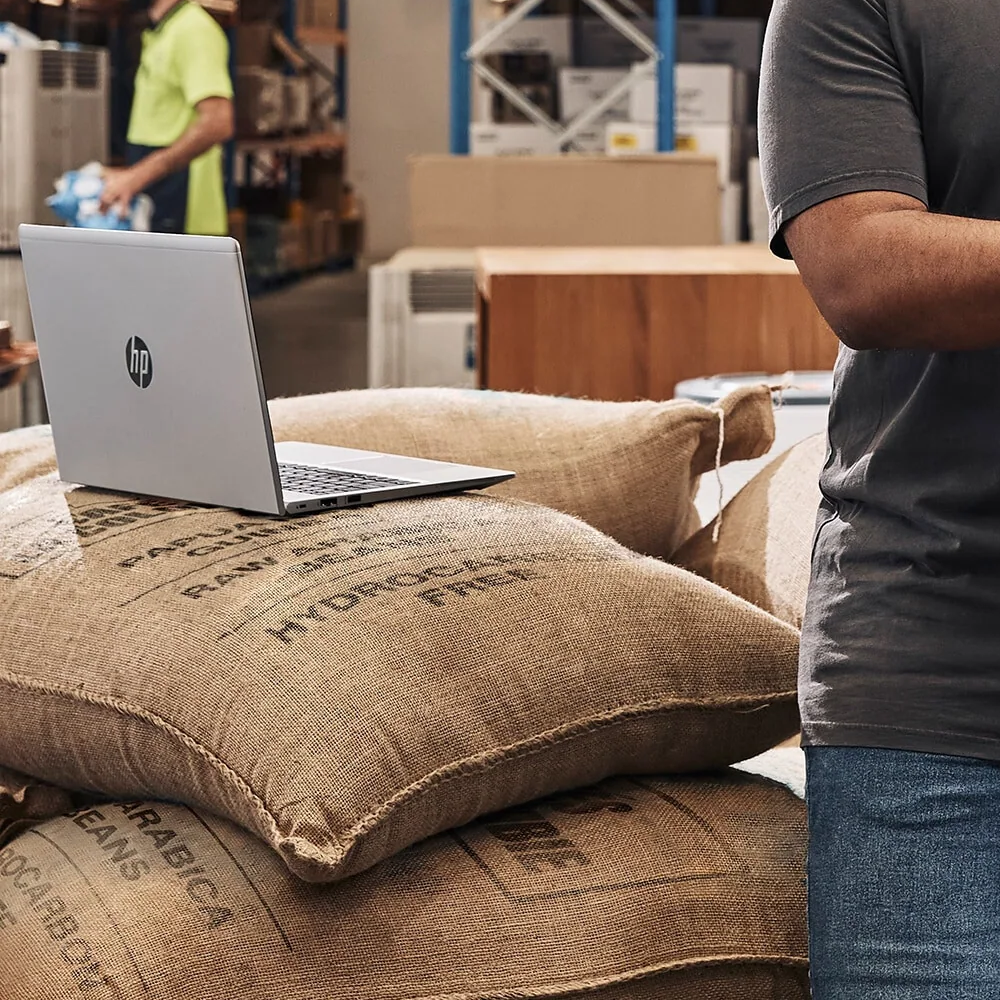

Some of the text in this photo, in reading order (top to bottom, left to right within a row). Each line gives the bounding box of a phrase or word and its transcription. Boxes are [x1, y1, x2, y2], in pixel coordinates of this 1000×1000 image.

[128, 335, 152, 389] hp
[116, 522, 270, 568] PAPUA
[180, 556, 279, 600] RAW
[68, 807, 151, 882] EANS
[113, 801, 234, 930] ARABICA
